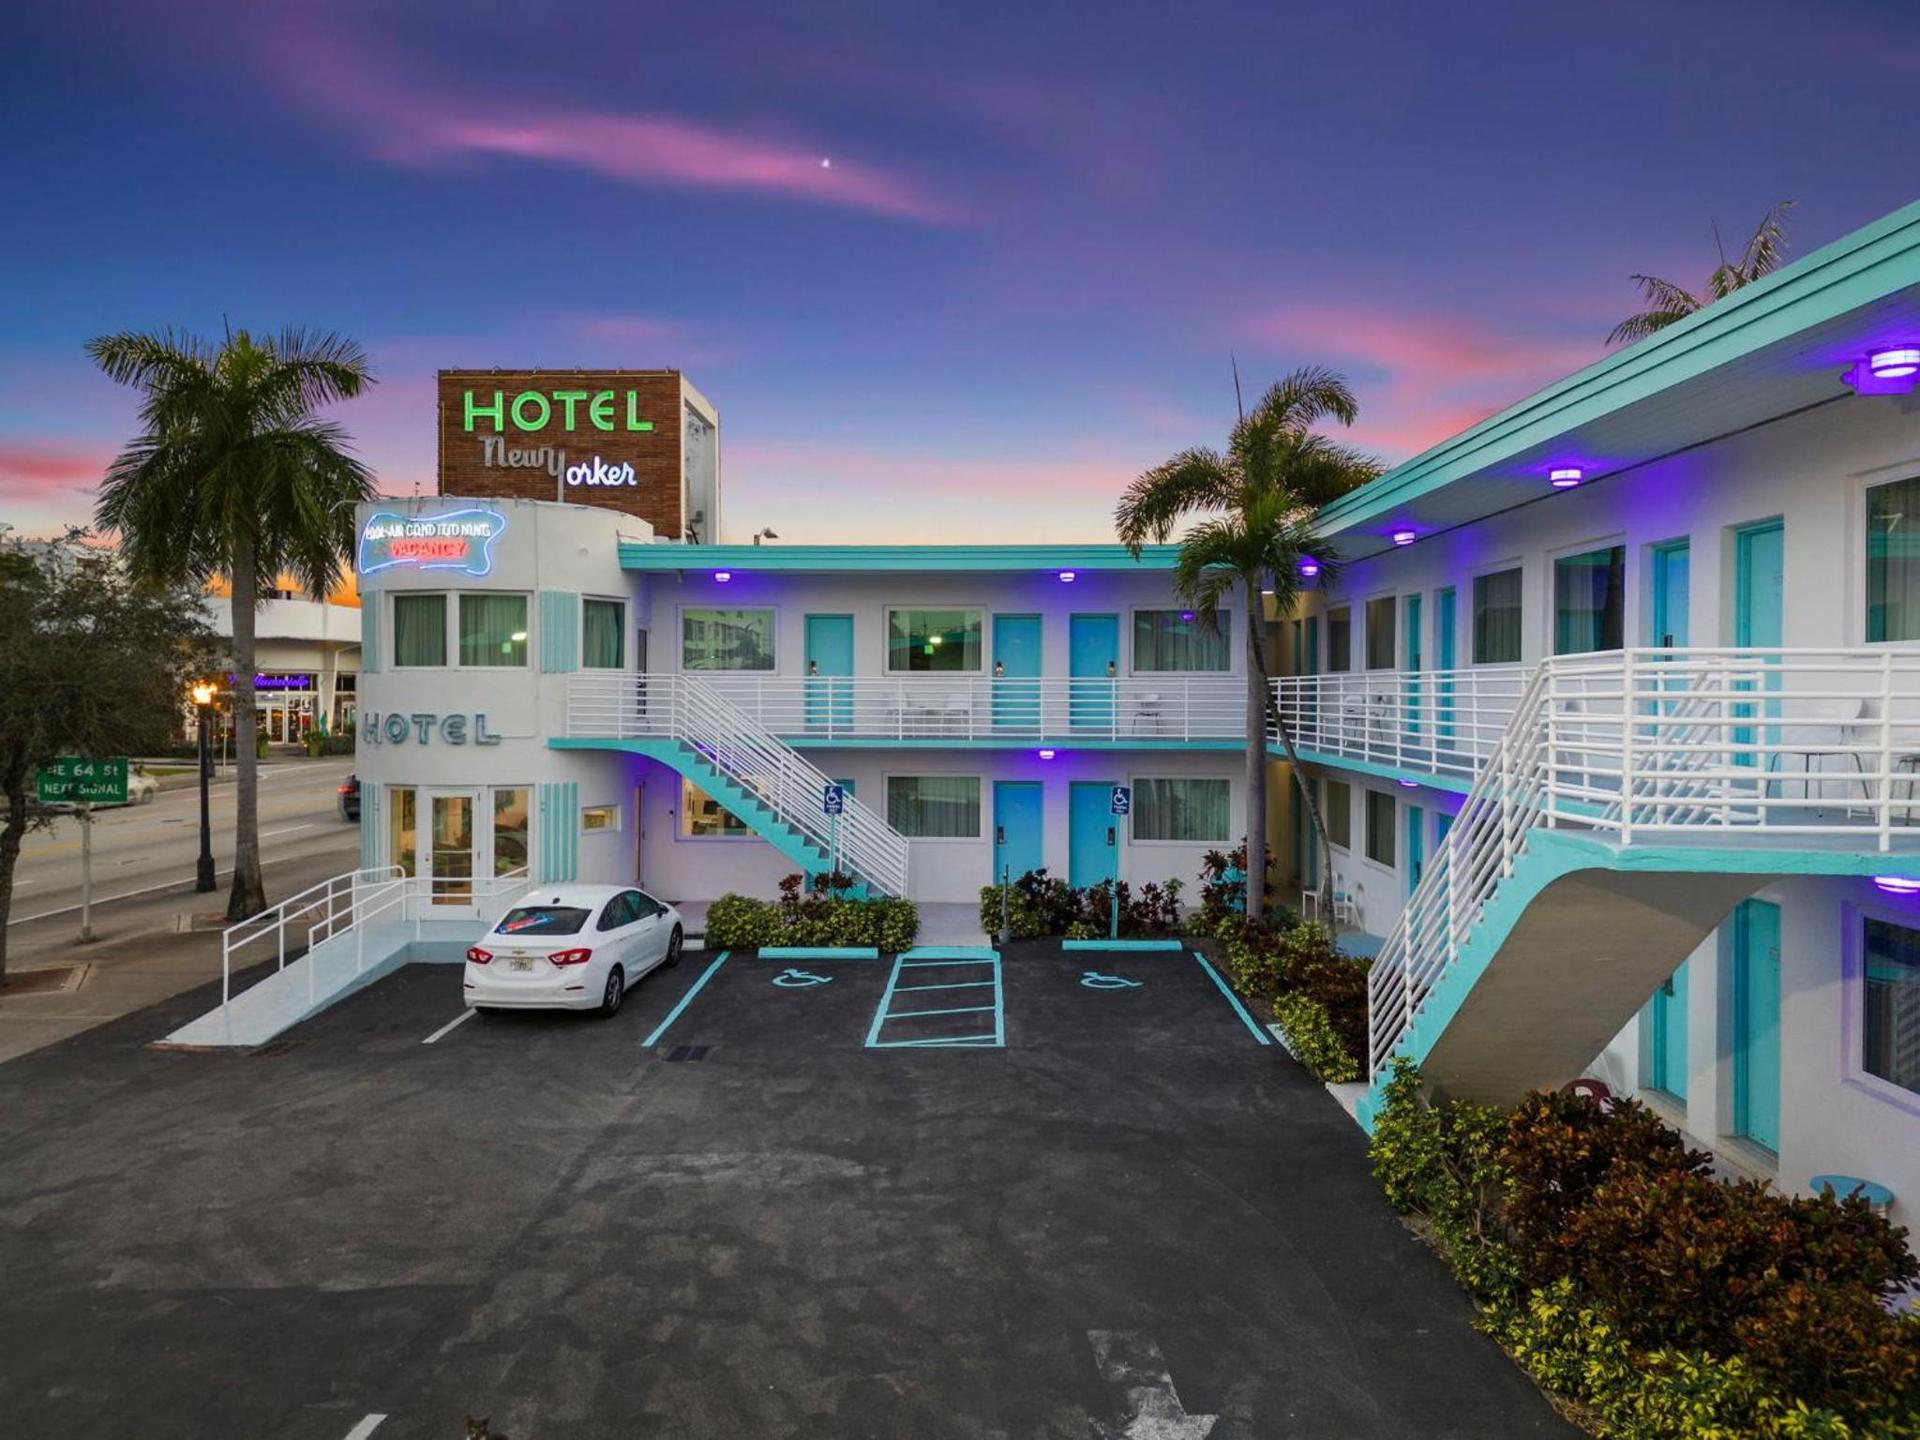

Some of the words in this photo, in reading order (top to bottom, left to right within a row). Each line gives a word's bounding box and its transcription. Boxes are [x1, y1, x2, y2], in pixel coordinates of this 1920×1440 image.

[464, 391, 653, 432] HOTEL
[405, 522, 491, 538] CONDITIONING
[390, 540, 467, 559] VACANCY
[362, 713, 501, 746] HOTEL
[73, 764, 95, 777] 64
[104, 765, 119, 776] St
[45, 783, 73, 794] NEXT
[79, 783, 121, 795] SIGNAL
